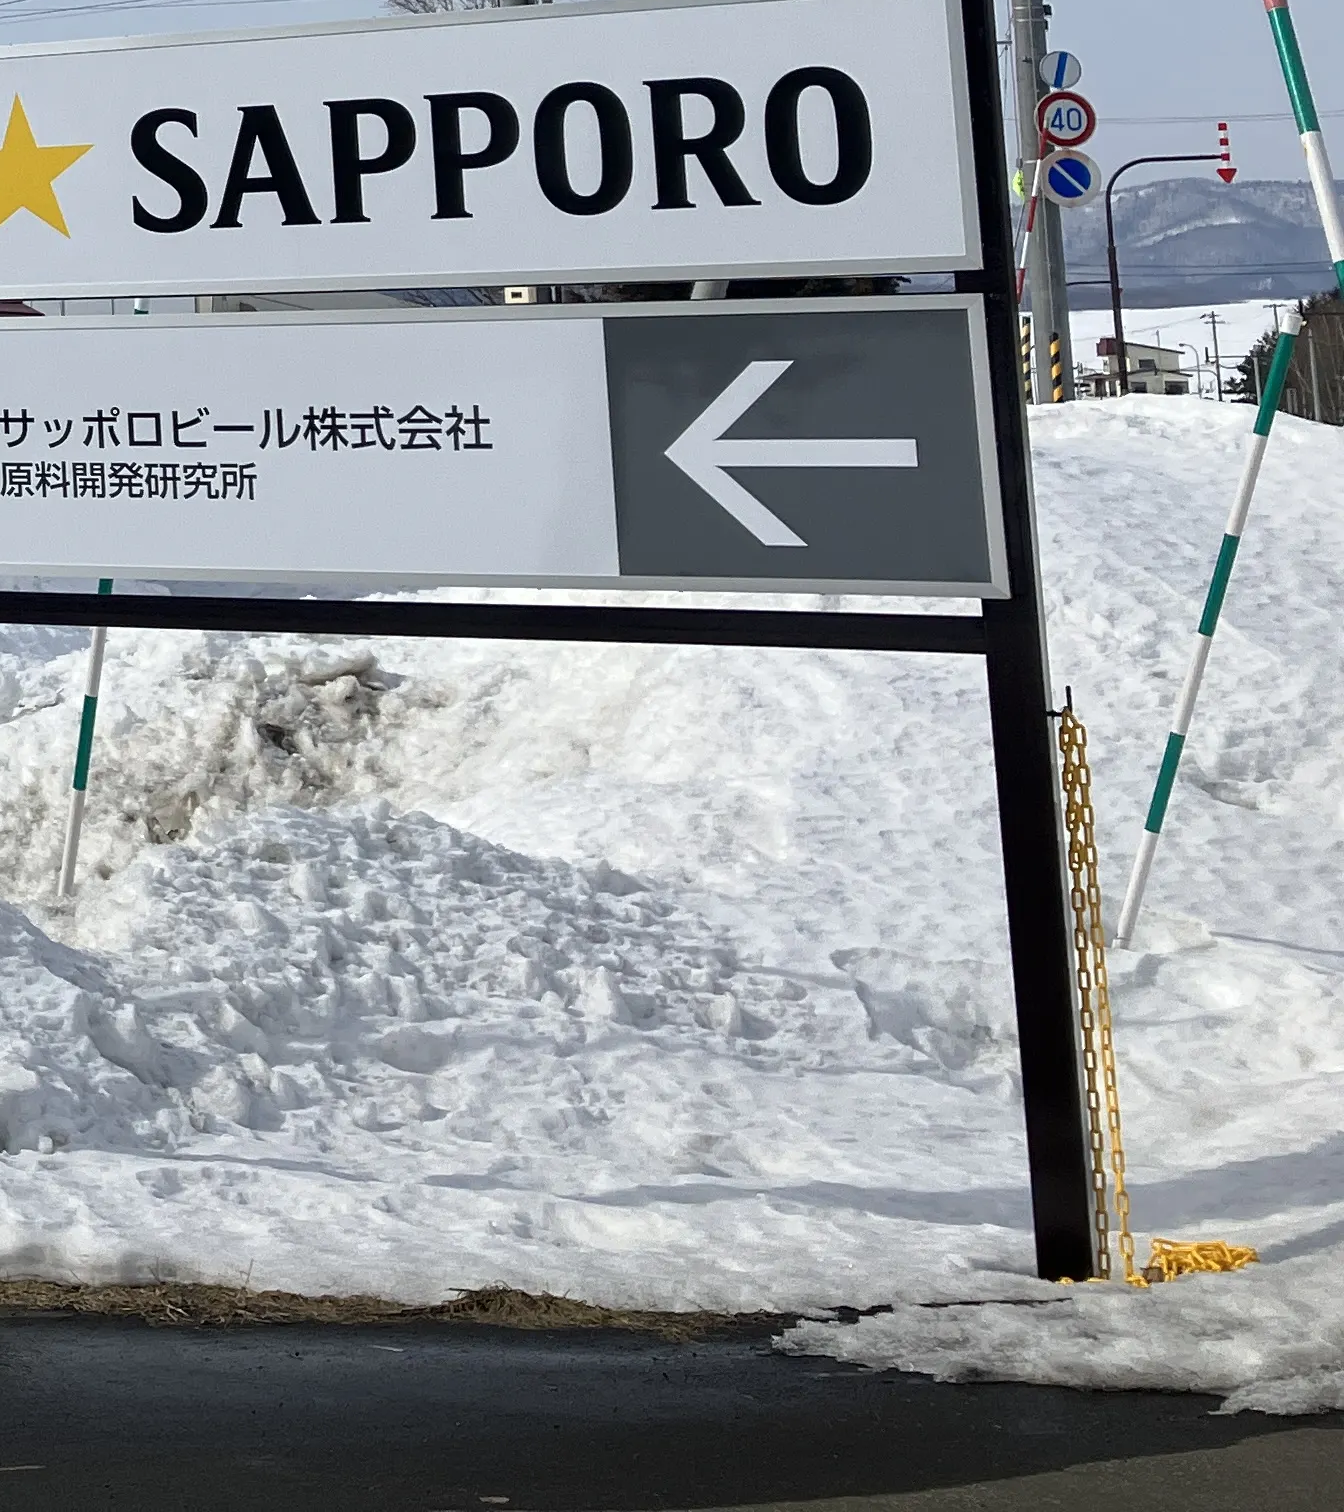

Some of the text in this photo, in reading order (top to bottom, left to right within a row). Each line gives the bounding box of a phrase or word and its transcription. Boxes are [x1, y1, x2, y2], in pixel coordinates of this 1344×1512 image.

[1050, 106, 1082, 131] 40
[130, 66, 873, 234] SAPPORO
[0, 460, 258, 501] 原料開発研究所
